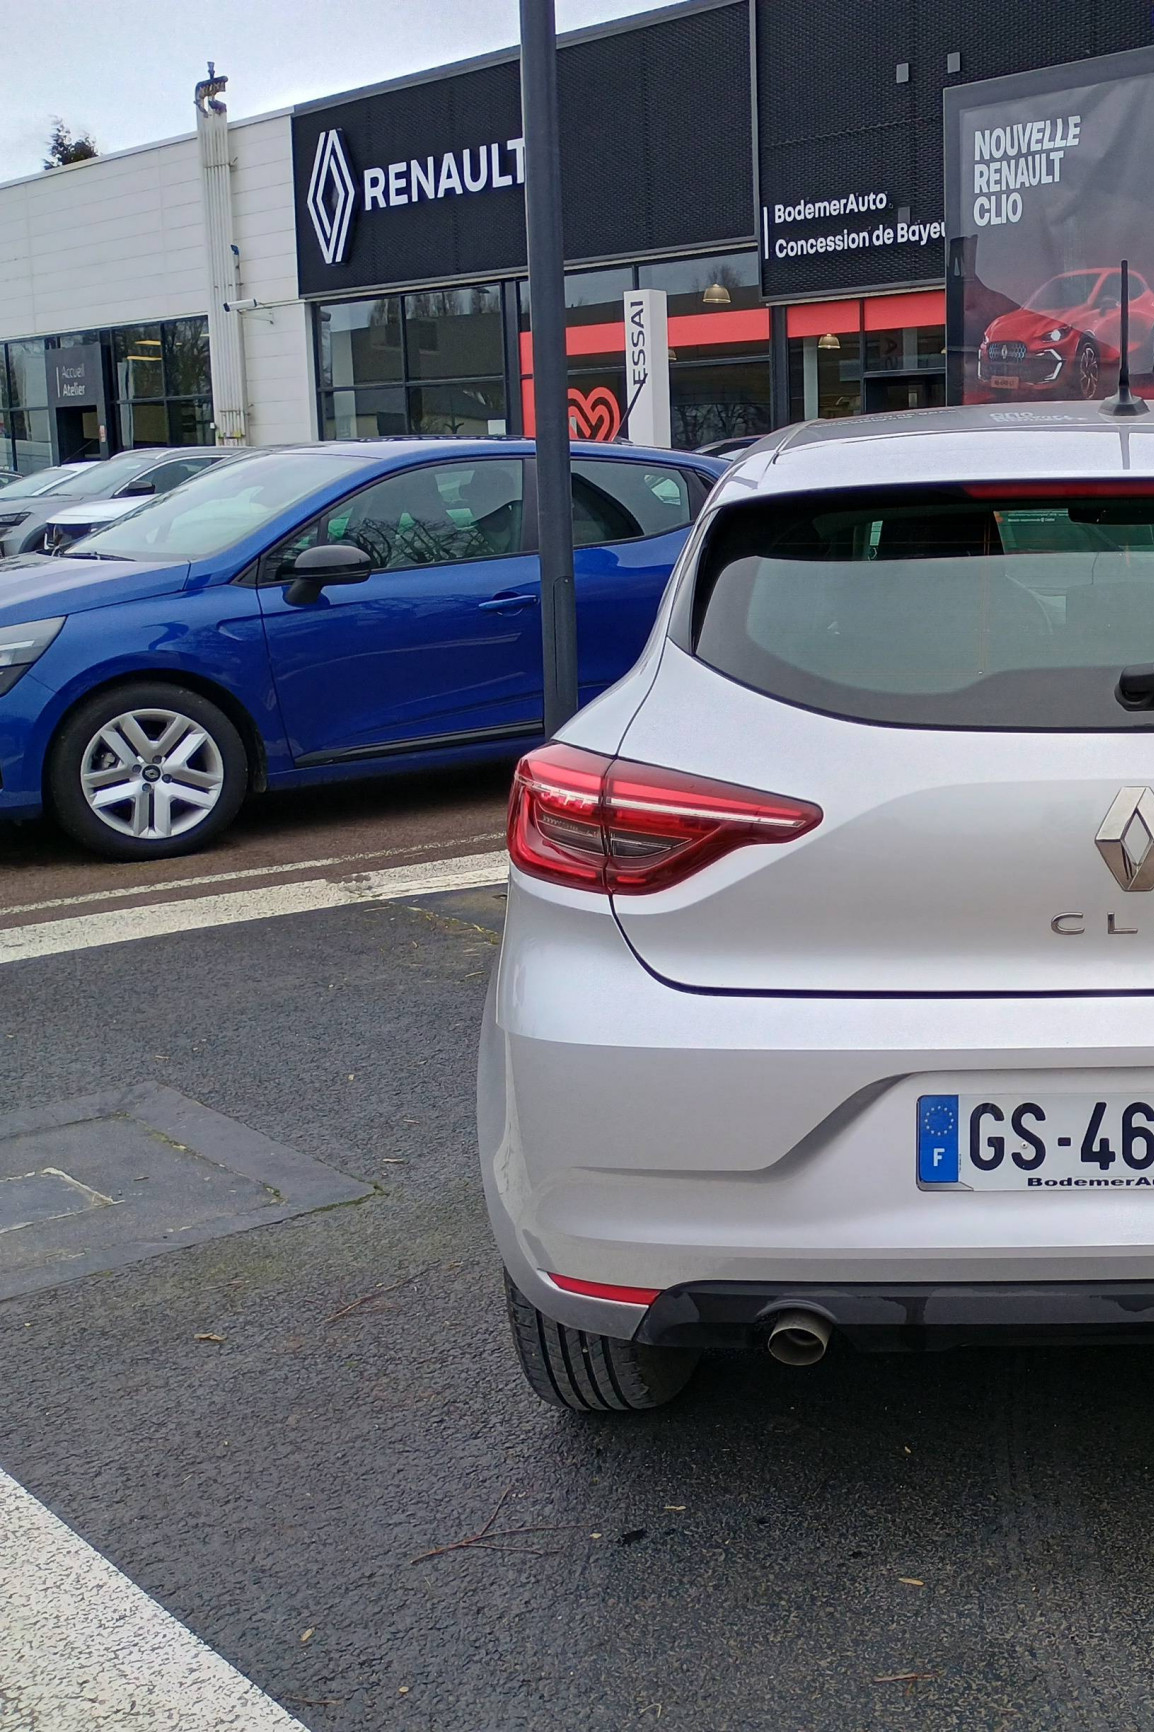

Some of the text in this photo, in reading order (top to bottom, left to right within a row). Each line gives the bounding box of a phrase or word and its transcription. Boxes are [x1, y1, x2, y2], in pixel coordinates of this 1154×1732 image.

[974, 116, 1081, 160] NOUVELLE
[363, 137, 525, 211] RENAULT
[974, 151, 1064, 193] RENAULT
[774, 192, 887, 223] BodemerAuto
[973, 192, 1022, 226] CLIO
[775, 229, 869, 258] Concession
[872, 225, 893, 246] de
[630, 300, 646, 385] ESSAI
[62, 363, 85, 378] Accueil
[63, 383, 85, 396] Atelier
[933, 1148, 945, 1167] F
